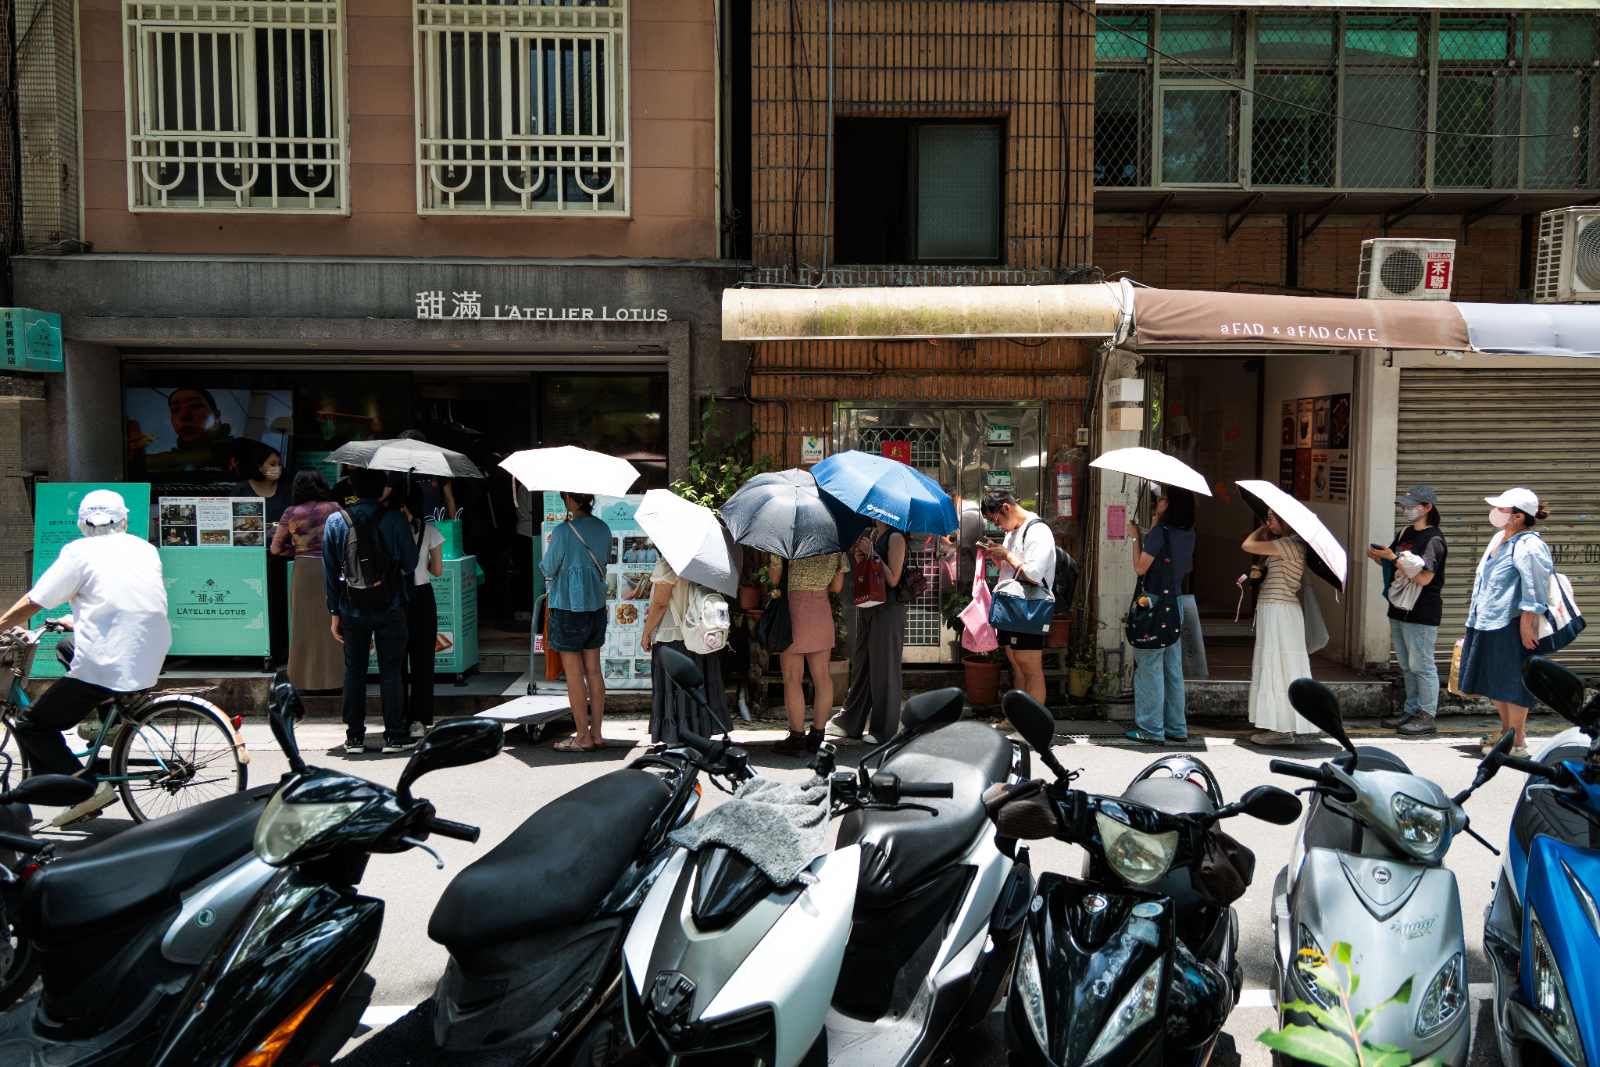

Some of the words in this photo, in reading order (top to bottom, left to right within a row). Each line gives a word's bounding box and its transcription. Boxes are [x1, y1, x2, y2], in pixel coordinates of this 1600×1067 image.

[1431, 262, 1446, 289] 禾聯
[415, 290, 482, 320] 甜滿
[494, 304, 594, 321] L'ATELIER
[602, 306, 668, 322] LOTUS
[1334, 327, 1379, 342] CAFE
[176, 607, 217, 615] L'ATELIER
